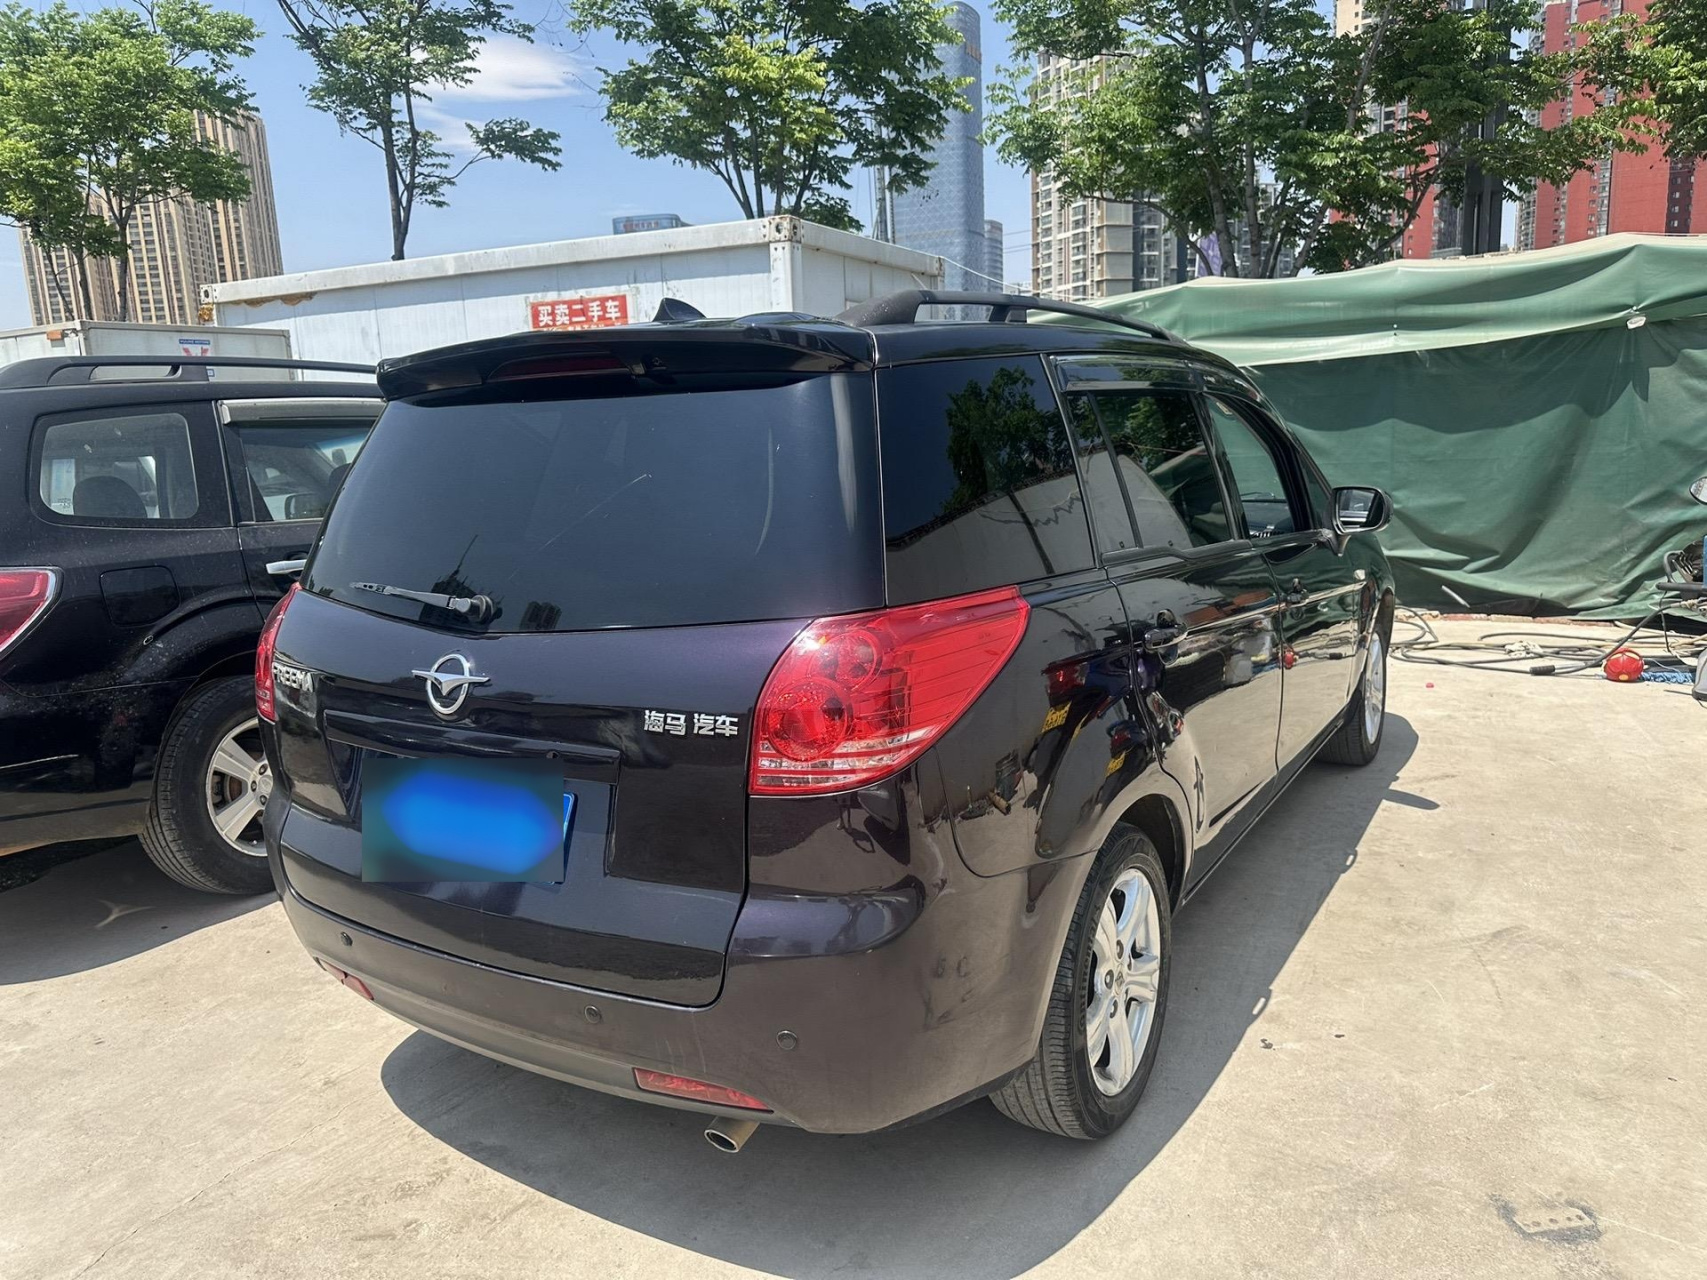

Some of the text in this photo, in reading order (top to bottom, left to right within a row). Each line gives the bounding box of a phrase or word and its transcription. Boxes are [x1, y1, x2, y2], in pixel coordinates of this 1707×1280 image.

[537, 299, 621, 327] 买卖二手车
[271, 661, 313, 692] FREEMA
[643, 709, 739, 737] 海马汽车
